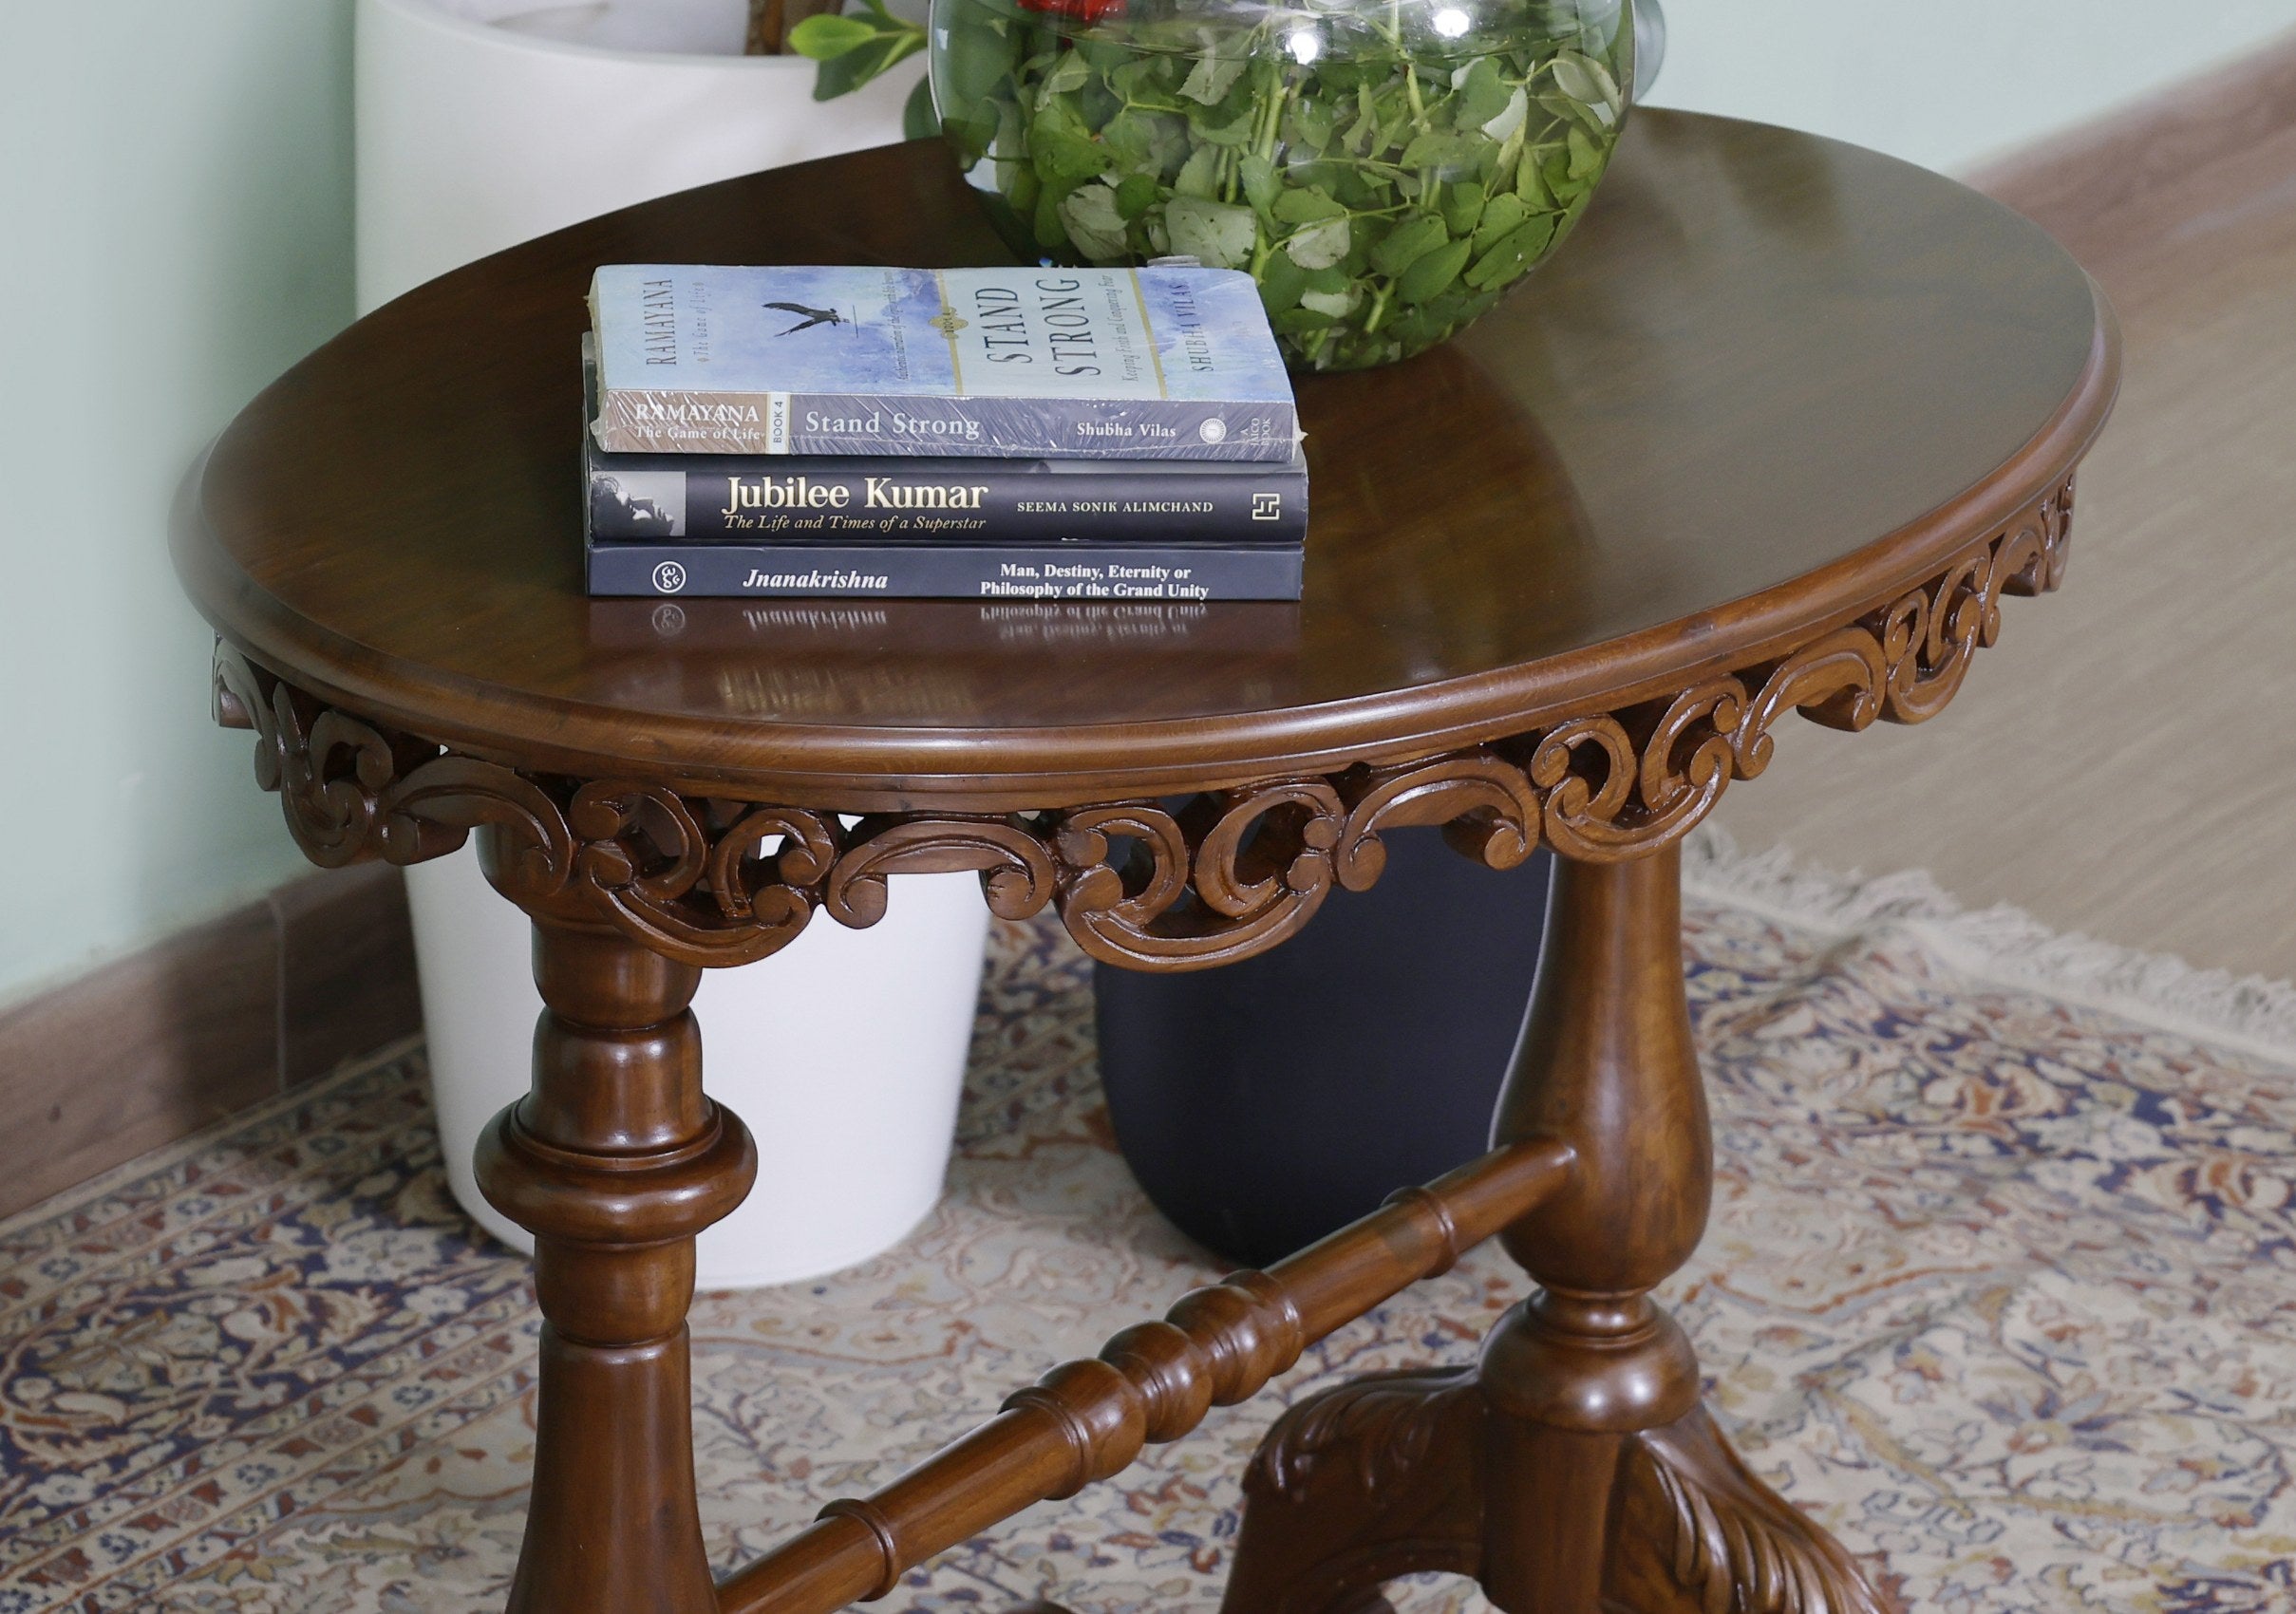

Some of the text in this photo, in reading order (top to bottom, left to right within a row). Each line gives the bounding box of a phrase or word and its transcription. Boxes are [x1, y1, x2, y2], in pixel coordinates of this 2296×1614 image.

[1103, 288, 1127, 322] Conquering
[643, 278, 676, 366] RAMAYANA
[974, 287, 1033, 364] STAND
[1036, 278, 1101, 376] STRONG
[1169, 284, 1214, 372] SHUBHA VILAS
[1121, 354, 1142, 382] Keeping
[635, 404, 760, 423] RAMAYANA
[773, 401, 783, 443] BOOK 4
[805, 411, 980, 440] Stand Strong
[635, 426, 761, 441] The Game of Life
[1077, 422, 1176, 438] Shubha Vilas
[1250, 418, 1260, 446] JAICO
[721, 476, 988, 516] Jubilee Kumar
[1017, 501, 1214, 513] SEEMA SONIK ALIMCHAND
[724, 514, 986, 533] The Life and Times of a Superstar
[743, 569, 889, 589] Jnanakrishna
[1000, 563, 1192, 580] Man, Destiny, Eternity or
[980, 581, 1210, 600] Philosophy of the Grand Unity
